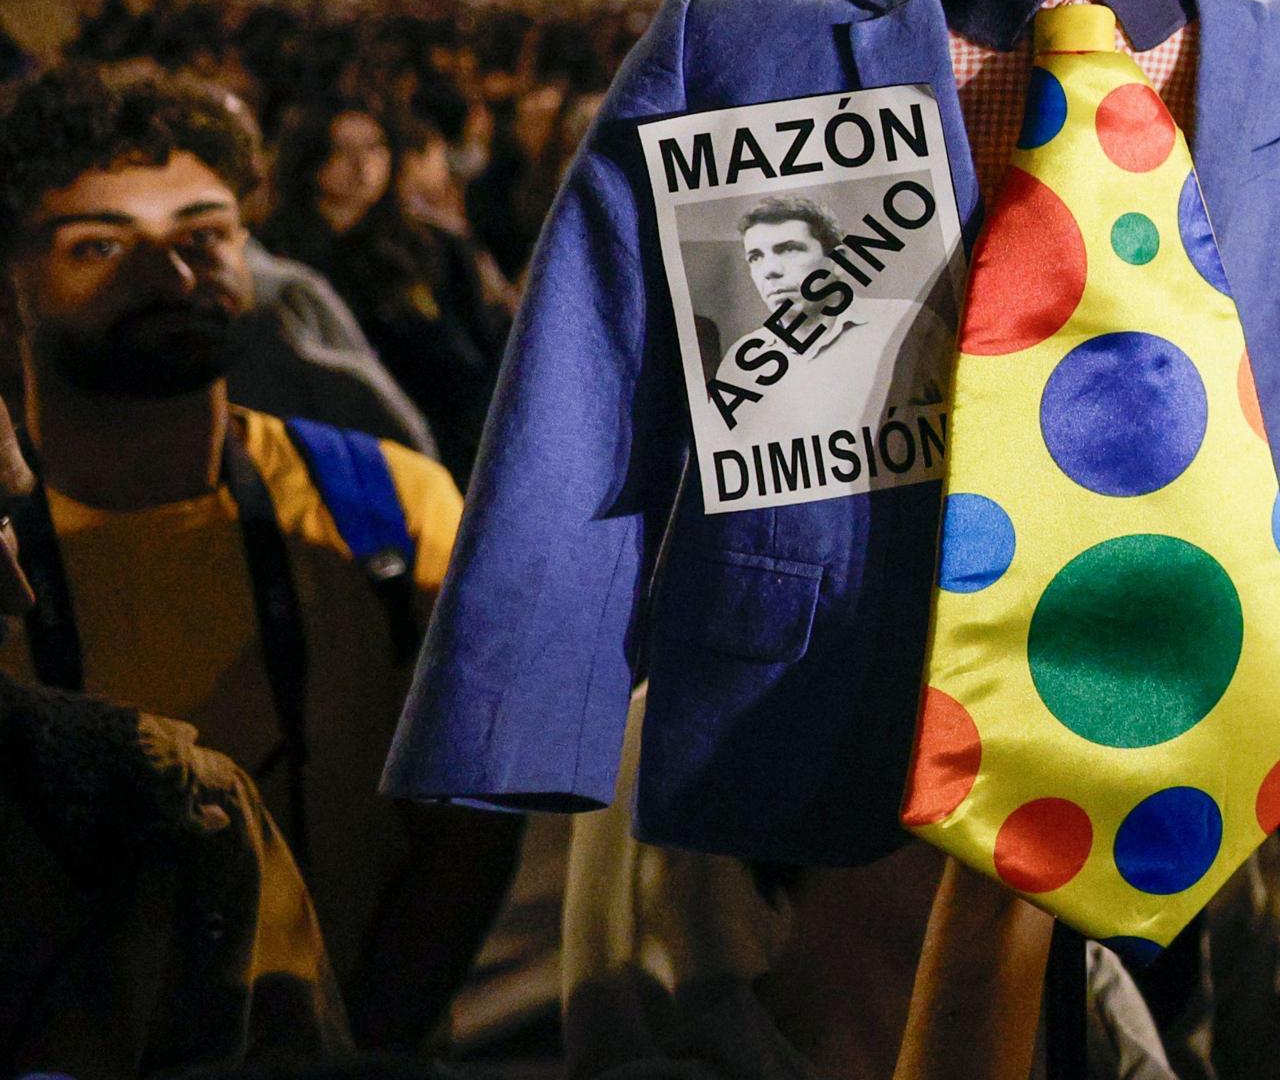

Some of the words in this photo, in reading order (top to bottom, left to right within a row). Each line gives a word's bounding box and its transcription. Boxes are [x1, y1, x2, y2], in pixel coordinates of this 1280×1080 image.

[658, 97, 930, 193] MAZÓN
[706, 179, 937, 431] ASESINO
[713, 406, 947, 502] DIMISIÓN
